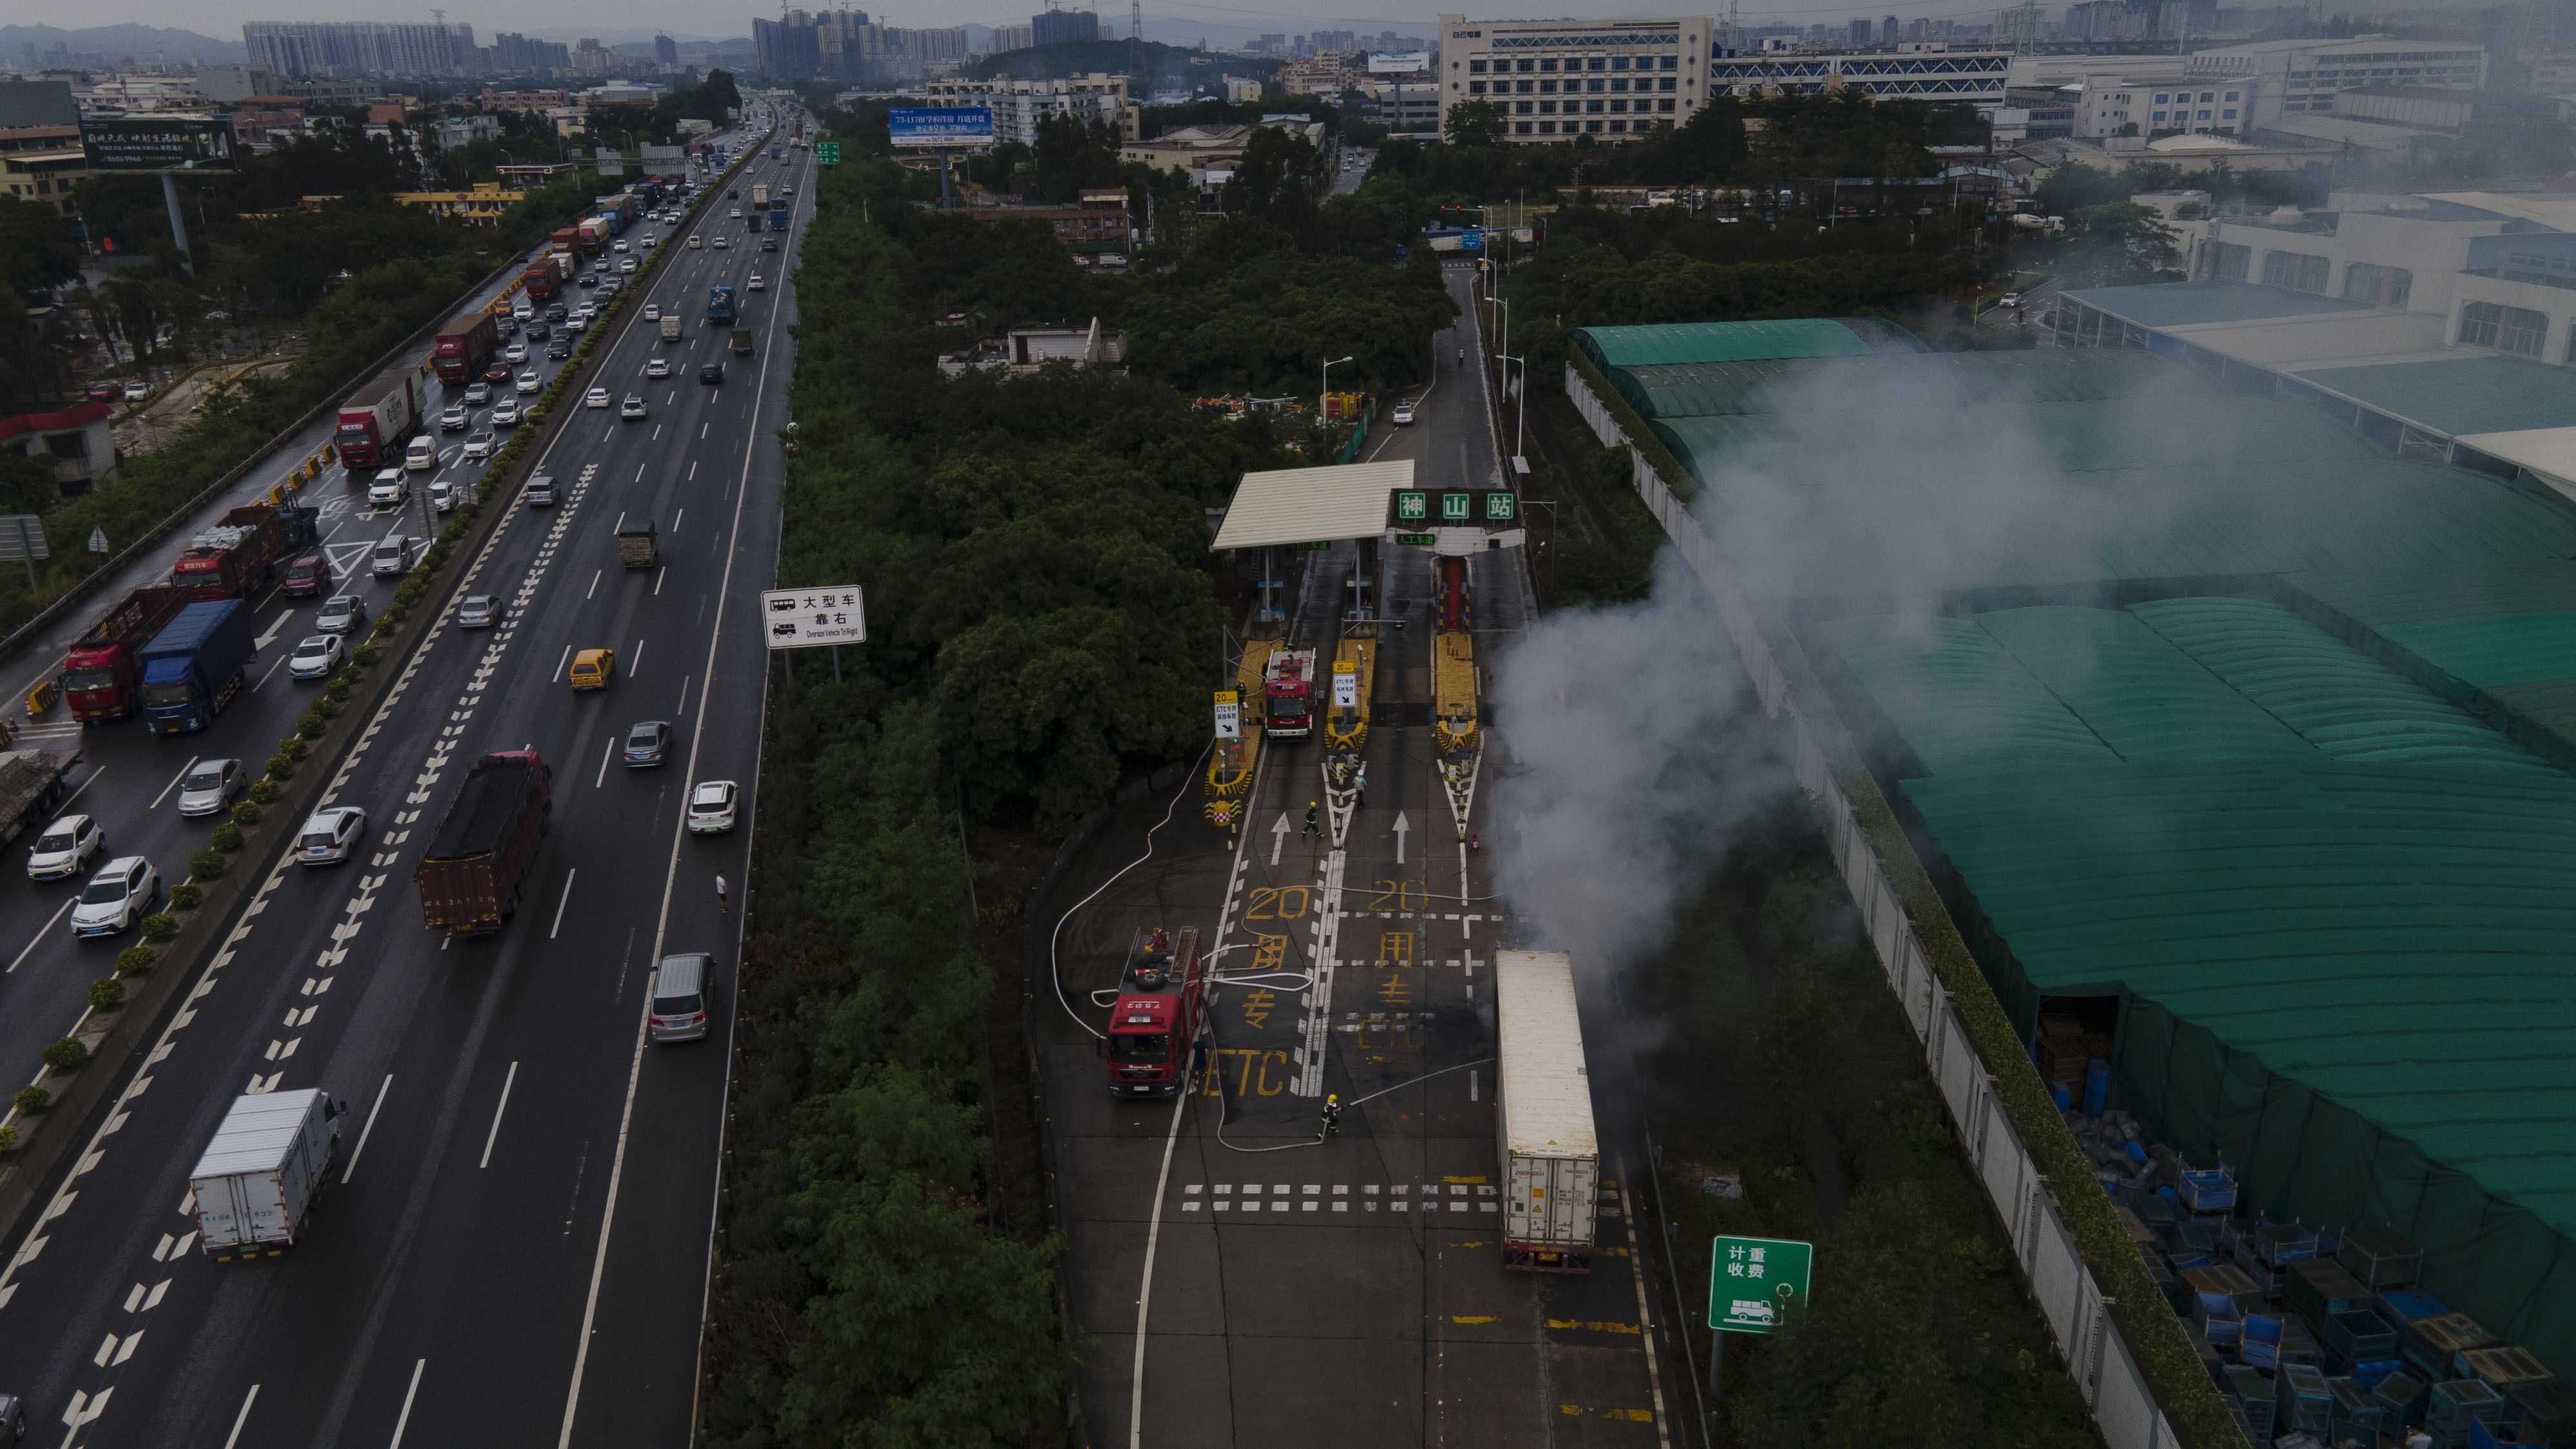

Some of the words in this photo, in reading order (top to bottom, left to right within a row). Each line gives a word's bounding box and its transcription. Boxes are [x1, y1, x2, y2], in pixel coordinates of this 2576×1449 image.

[1403, 495, 1511, 516] 神山站
[1399, 536, 1434, 544] 人工车道
[804, 594, 855, 609] 大型车
[815, 612, 847, 625] 靠右
[806, 630, 825, 638] Oversize
[847, 627, 858, 637] Right
[1216, 694, 1226, 702] 20
[1245, 887, 1309, 919] 20
[1368, 879, 1428, 912] 20
[1252, 934, 1288, 971] 用
[1379, 932, 1414, 968] 用
[1242, 989, 1276, 1030] 专
[1203, 1049, 1287, 1096] ETC
[1728, 1245, 1766, 1262] 计重
[1727, 1262, 1764, 1279] 收费
